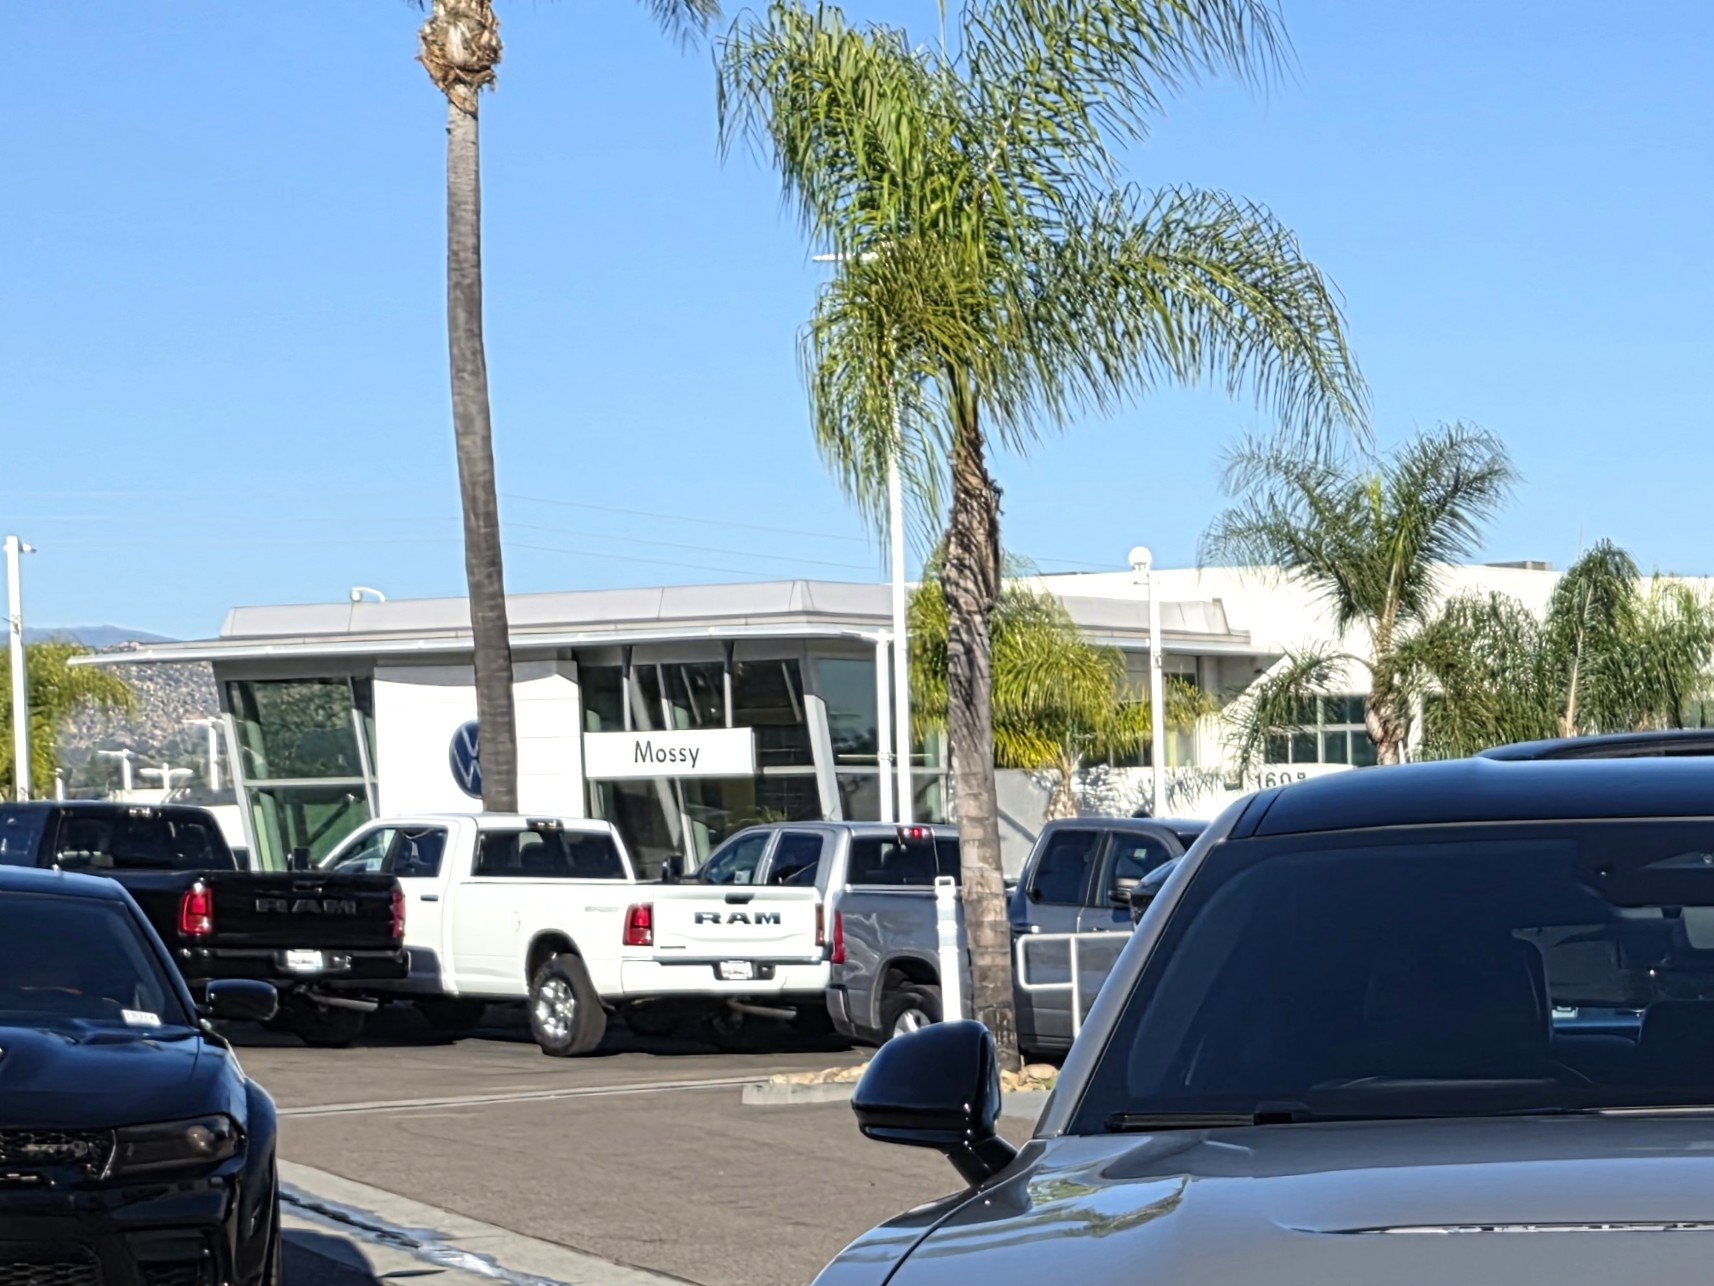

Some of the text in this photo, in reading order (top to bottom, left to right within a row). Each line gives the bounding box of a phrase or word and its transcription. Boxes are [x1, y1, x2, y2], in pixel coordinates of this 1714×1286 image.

[634, 740, 700, 769] Mossy
[256, 898, 357, 915] RAM
[694, 911, 782, 925] RAM
